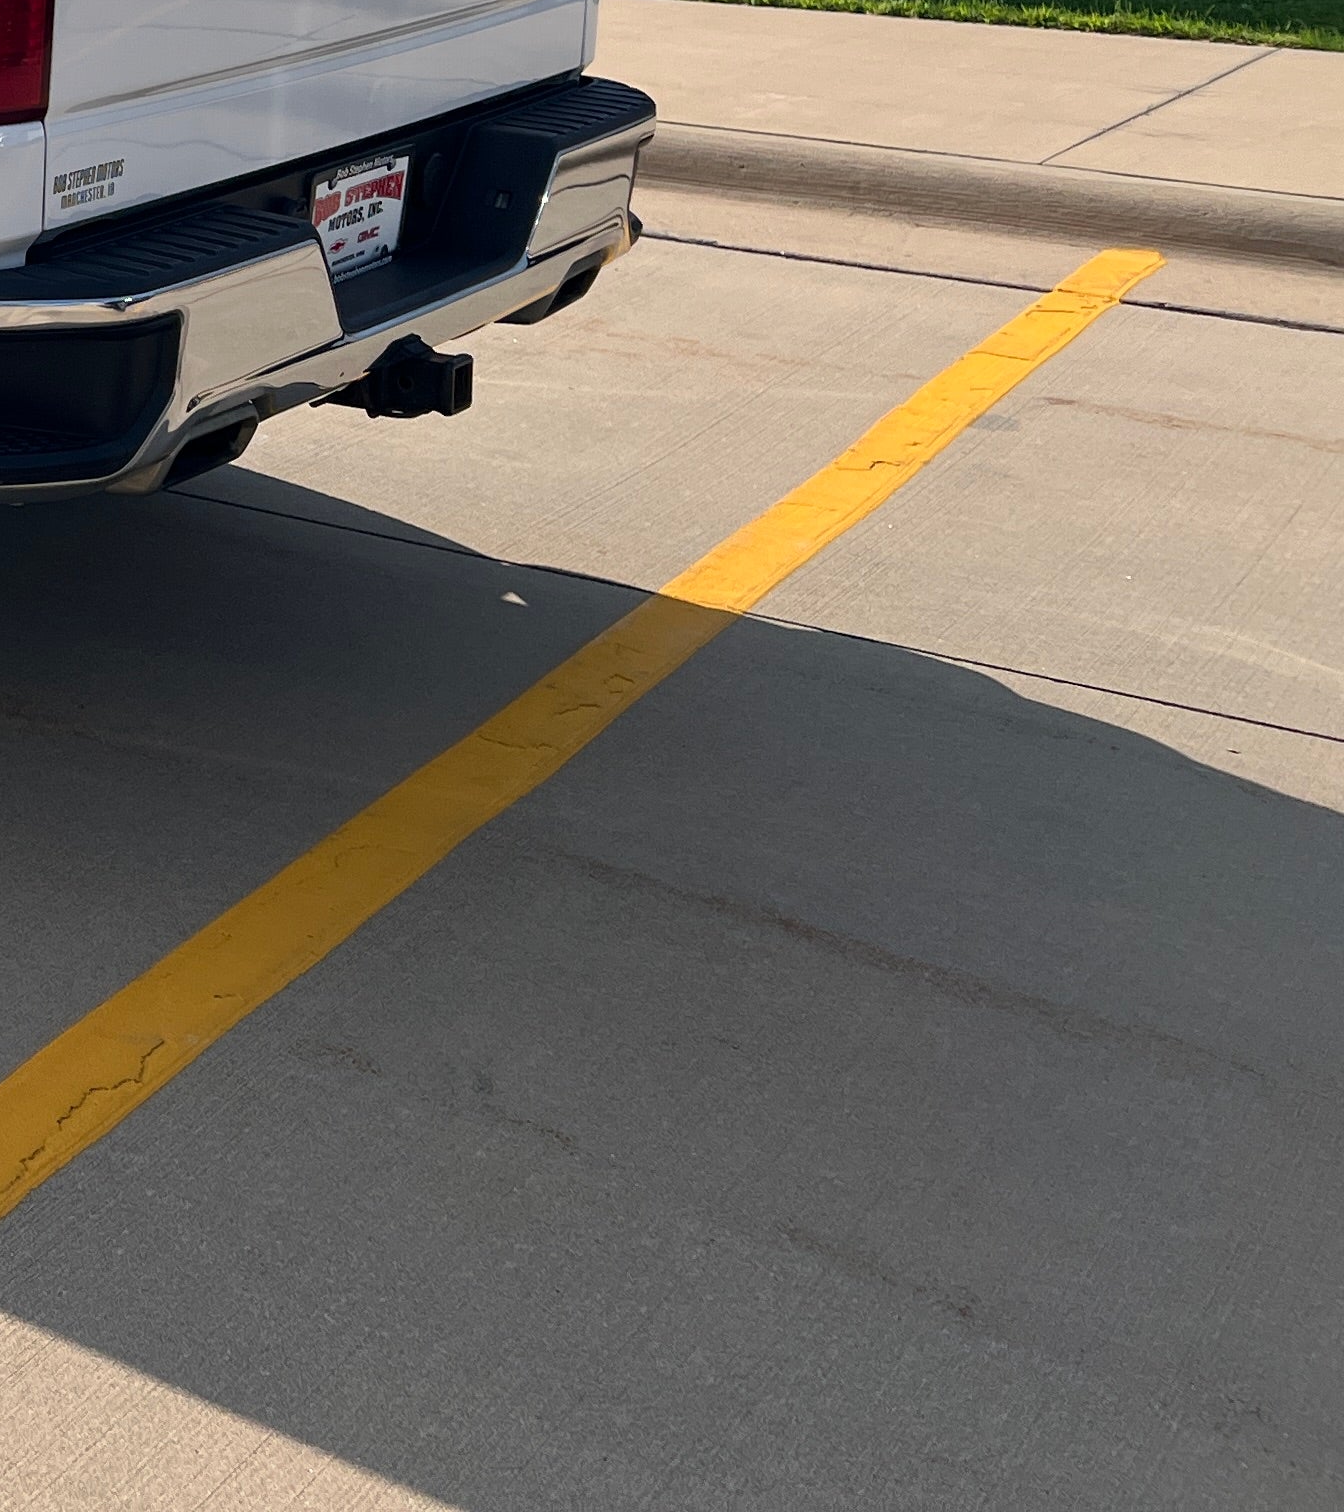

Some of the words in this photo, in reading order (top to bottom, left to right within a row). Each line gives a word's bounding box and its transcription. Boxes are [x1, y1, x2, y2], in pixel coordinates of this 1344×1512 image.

[53, 174, 68, 194] BOB
[67, 166, 97, 190] STEPHEN
[96, 159, 124, 182] MOTORS
[314, 191, 342, 228] BOB
[344, 170, 405, 207] STEPHEN
[328, 206, 365, 232] MOTORS,
[368, 201, 384, 219] INC.
[357, 225, 380, 243] GMC
